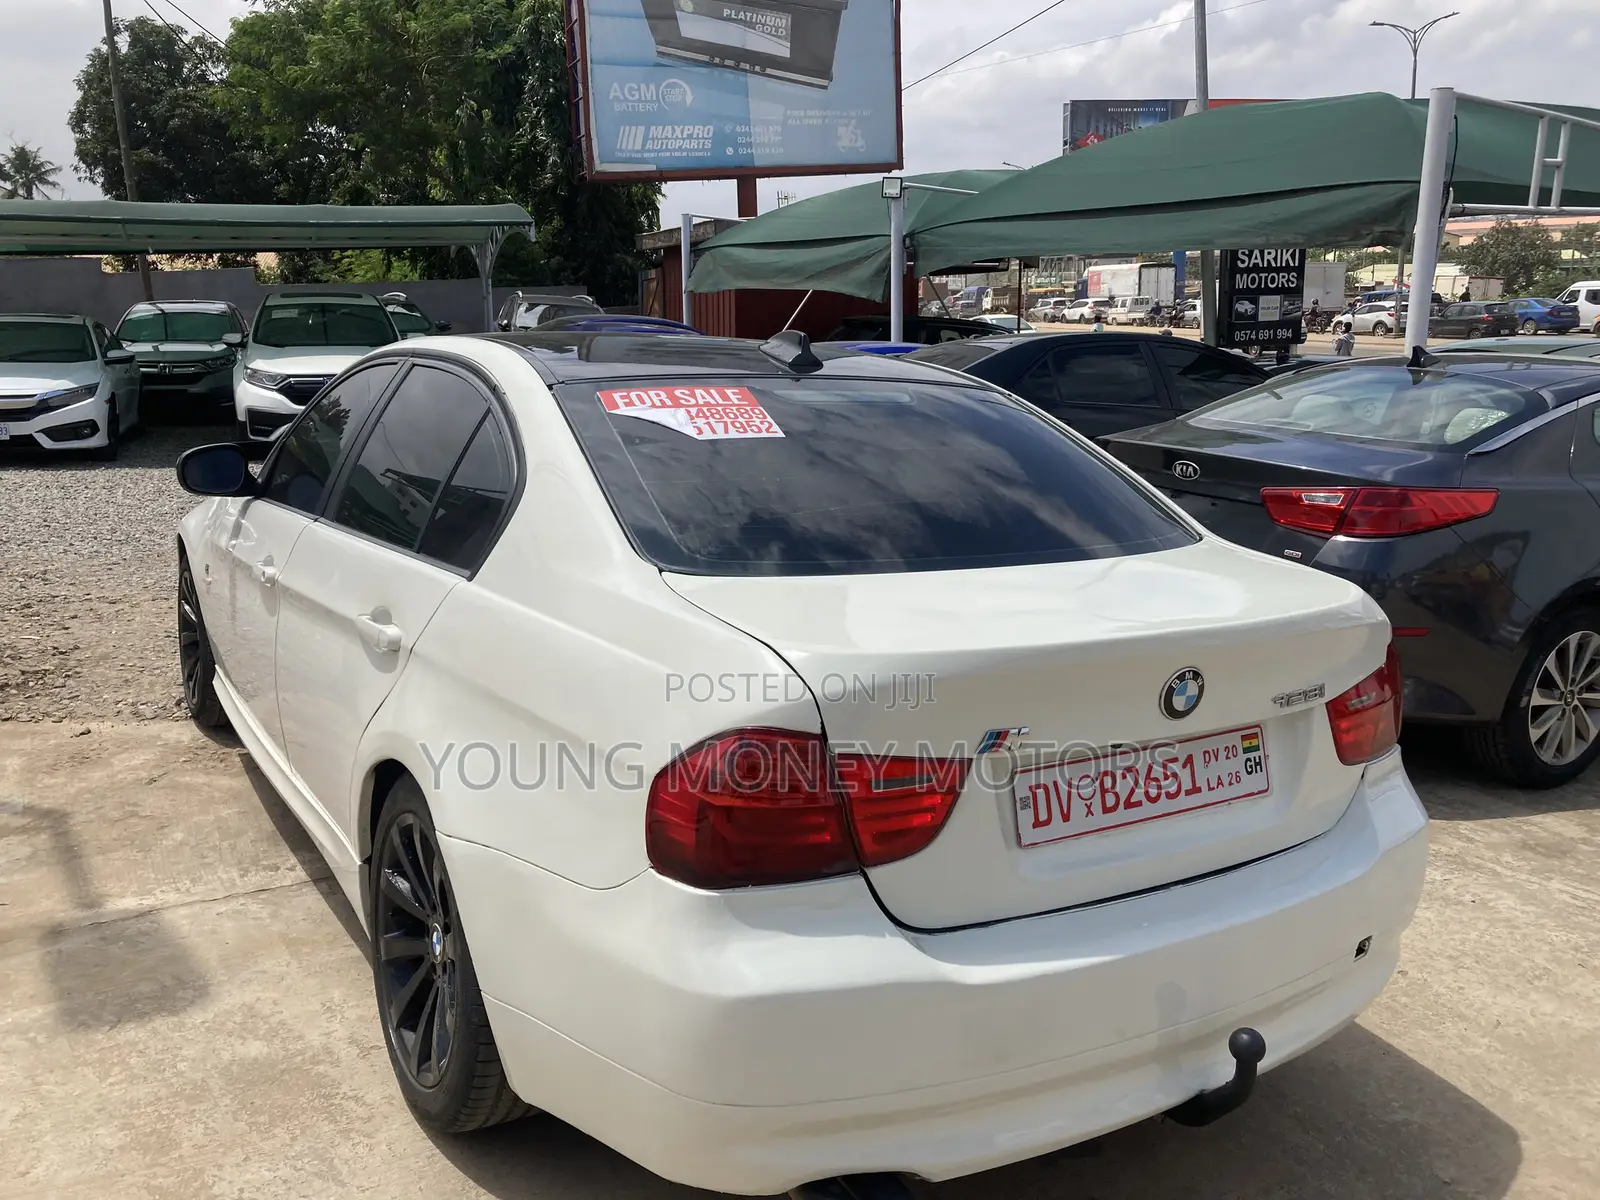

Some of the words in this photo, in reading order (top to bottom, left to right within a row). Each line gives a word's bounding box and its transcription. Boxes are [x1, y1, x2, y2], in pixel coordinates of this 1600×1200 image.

[723, 9, 787, 28] PLATINUM
[755, 24, 787, 36] GOLD
[609, 82, 657, 101] AGM
[663, 88, 685, 96] START
[613, 102, 658, 112] BATTERY
[648, 125, 714, 139] MAXPRO
[645, 139, 712, 151] AUTOPARTS
[1236, 248, 1300, 269] SARIKI
[1235, 272, 1298, 290] MOTORS
[1234, 330, 1256, 341] 0574
[1258, 329, 1273, 340] 691
[1276, 328, 1292, 339] 994
[611, 390, 673, 409] FOR
[673, 388, 748, 406] SALE
[1175, 463, 1196, 477] KIA
[1284, 550, 1301, 558] GDI
[1171, 671, 1203, 689] BMW
[1202, 747, 1220, 765] DV
[1223, 744, 1239, 760] 20
[1244, 755, 1263, 776] GH
[1206, 774, 1225, 792] LA
[1227, 770, 1242, 787] 26
[1028, 778, 1073, 829] DV
[1098, 753, 1203, 815] B2651
